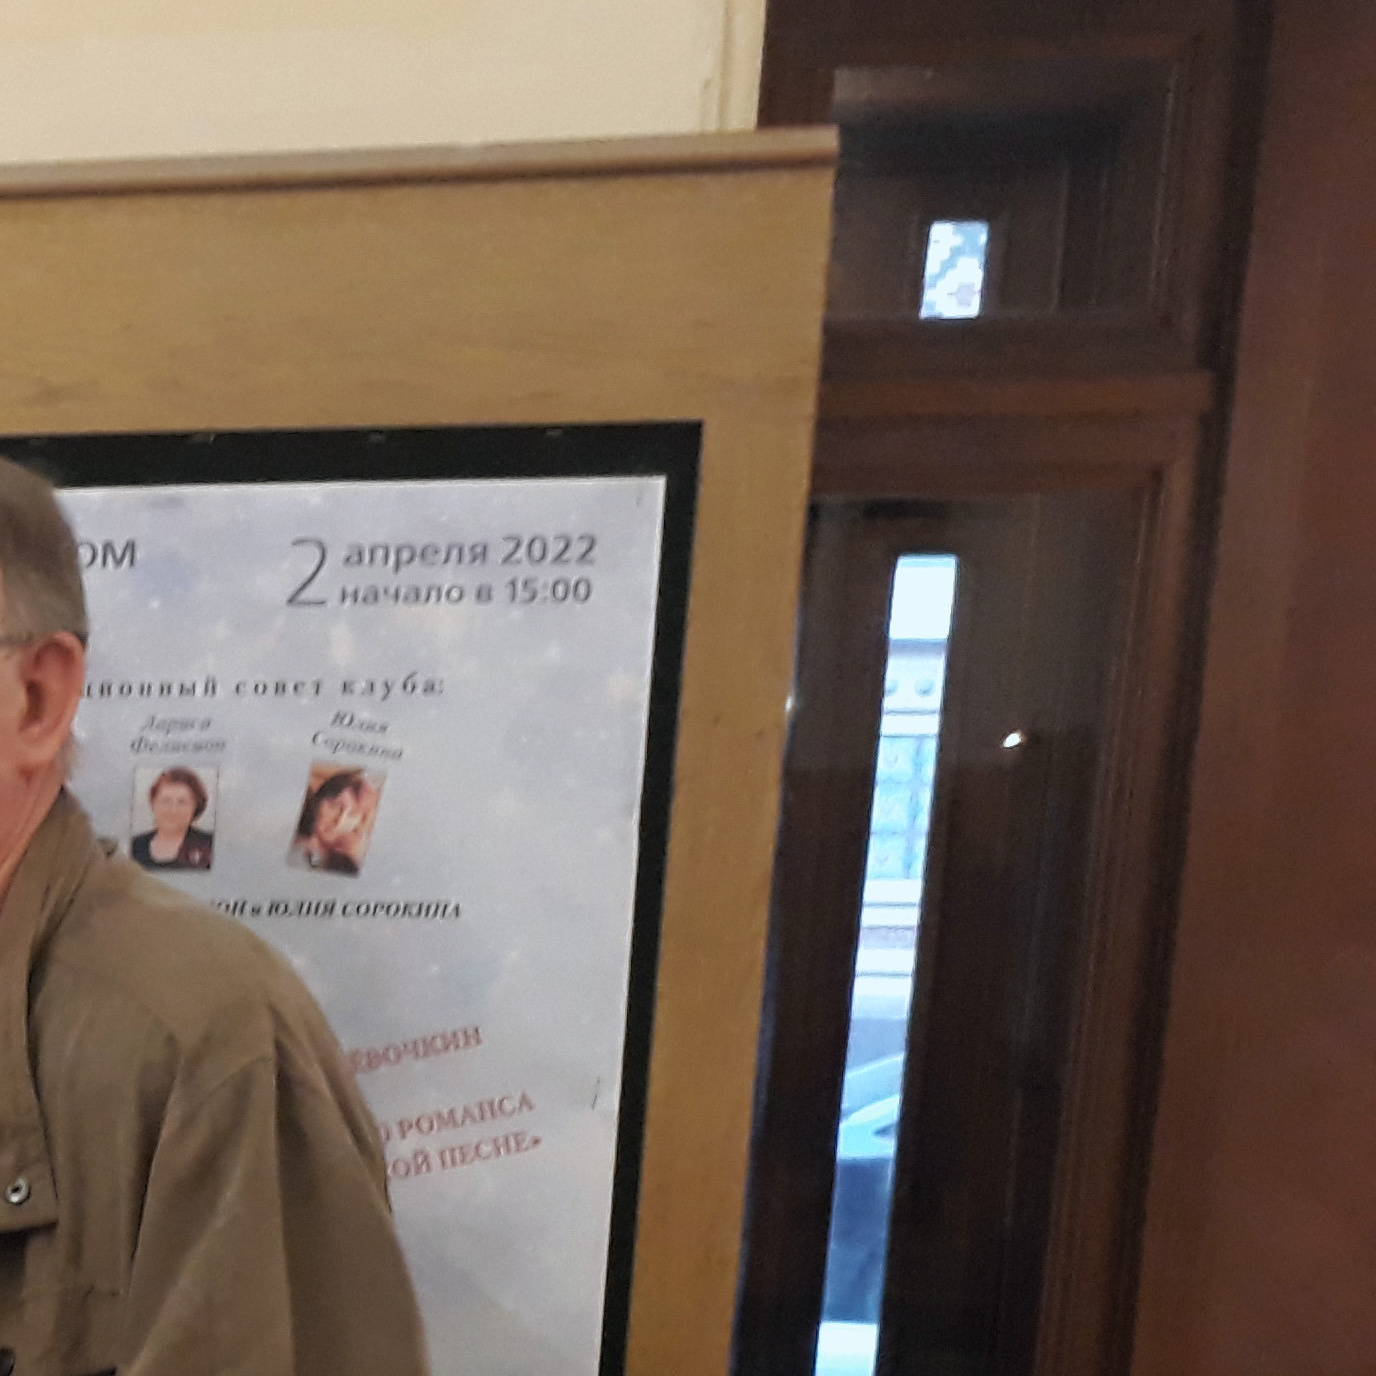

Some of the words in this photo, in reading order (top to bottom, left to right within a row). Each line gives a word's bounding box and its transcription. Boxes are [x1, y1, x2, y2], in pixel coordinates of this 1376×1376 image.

[286, 536, 328, 607] 2
[342, 542, 488, 574] апреля
[499, 534, 597, 567] 2022
[341, 580, 465, 606] начало
[477, 583, 493, 602] в
[505, 577, 592, 605] 15:00
[235, 678, 322, 698] совет
[341, 672, 443, 701] клуба:
[398, 1090, 536, 1140] РОМАНСА
